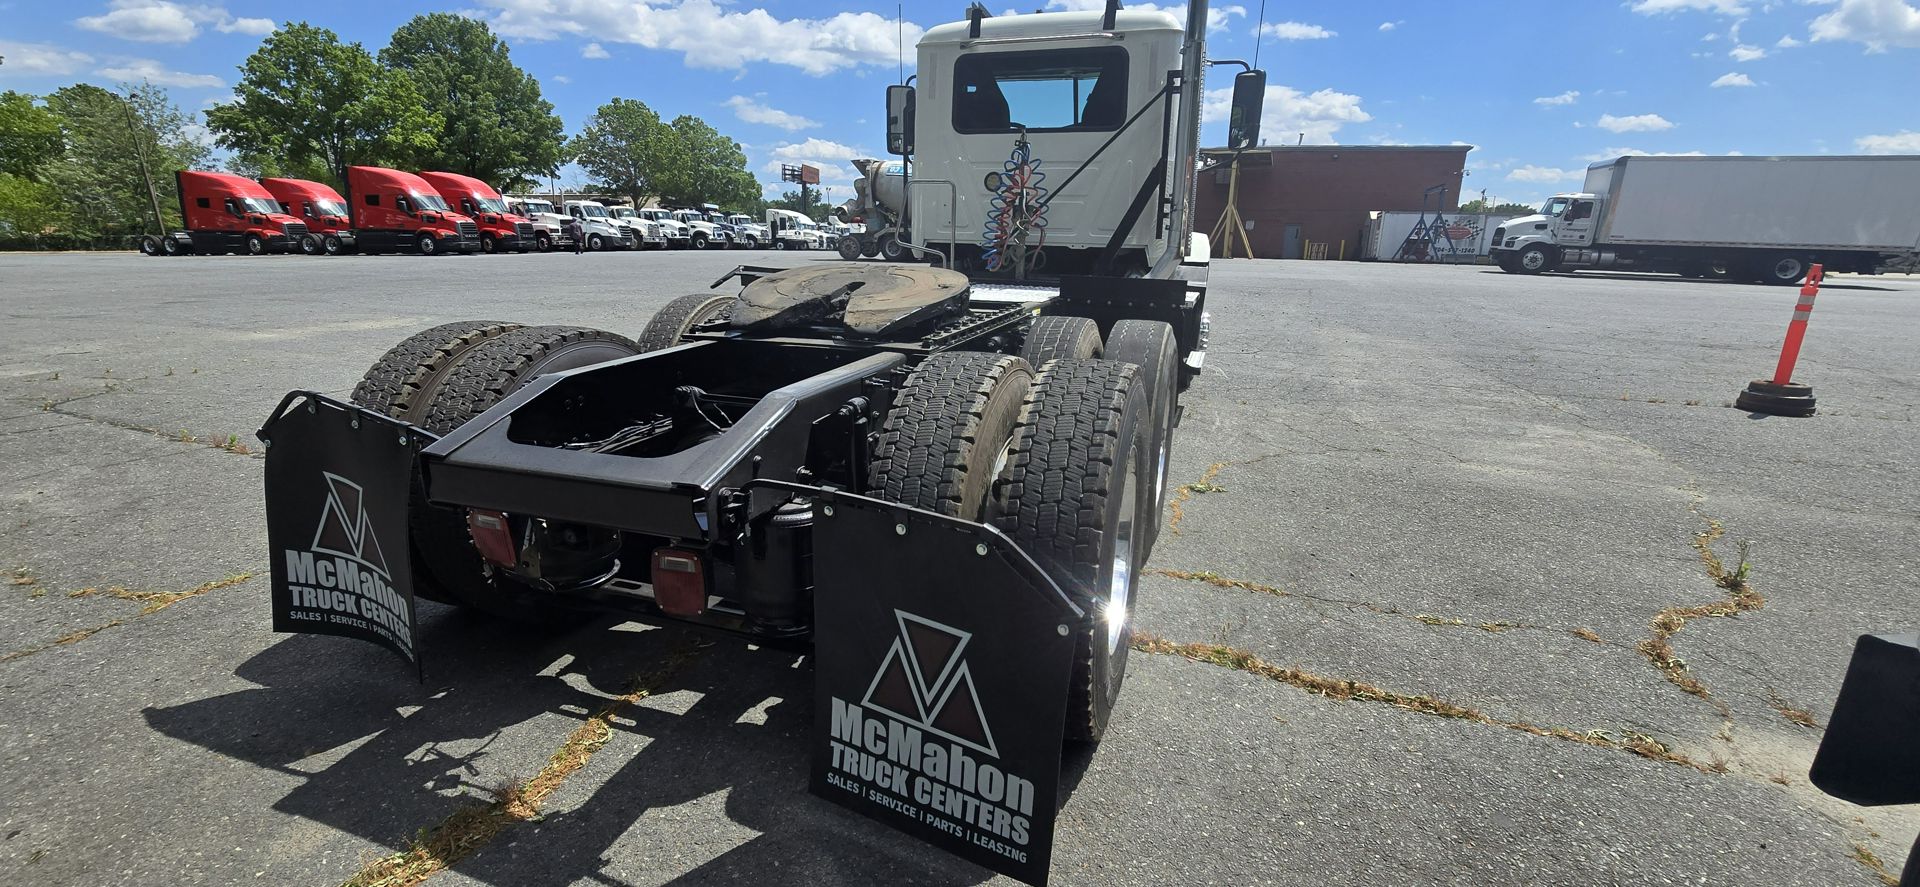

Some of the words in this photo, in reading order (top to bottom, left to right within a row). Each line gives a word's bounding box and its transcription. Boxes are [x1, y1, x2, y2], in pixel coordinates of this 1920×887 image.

[285, 549, 410, 627] McMahon
[288, 585, 358, 615] TRUCK
[360, 598, 413, 649] CENTERS
[290, 610, 321, 621] SALES
[330, 614, 367, 629] SERVICE
[373, 624, 392, 641] PARTS
[830, 741, 910, 798] TRUCK
[913, 776, 1030, 846] CENTERS
[831, 696, 1035, 817] McMahon
[827, 773, 859, 794] SALES
[869, 790, 917, 818] SERVICE
[926, 814, 963, 837] PARTS
[973, 833, 1028, 864] LEASING
